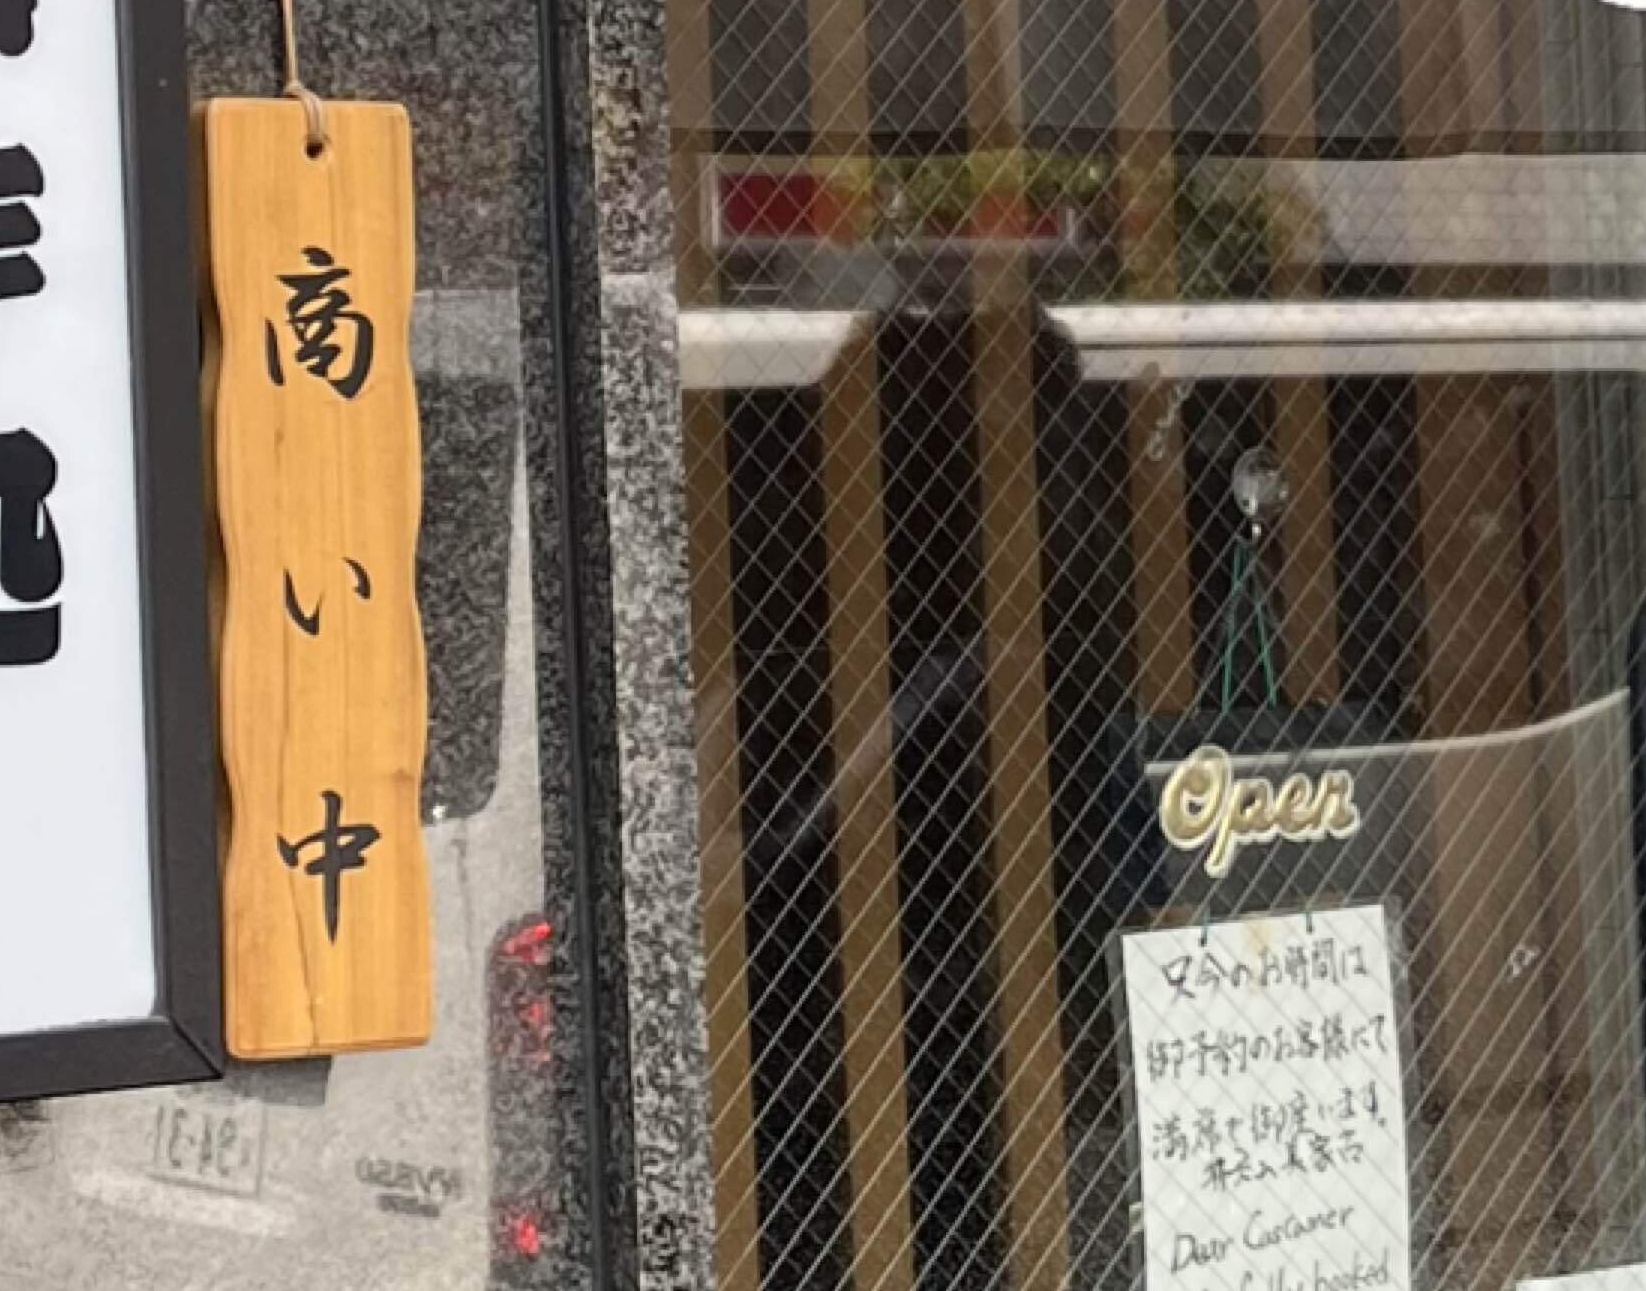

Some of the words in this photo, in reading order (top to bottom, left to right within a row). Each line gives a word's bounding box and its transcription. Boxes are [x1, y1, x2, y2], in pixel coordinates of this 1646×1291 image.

[267, 248, 380, 941] 商い中
[1160, 745, 1361, 878] Open
